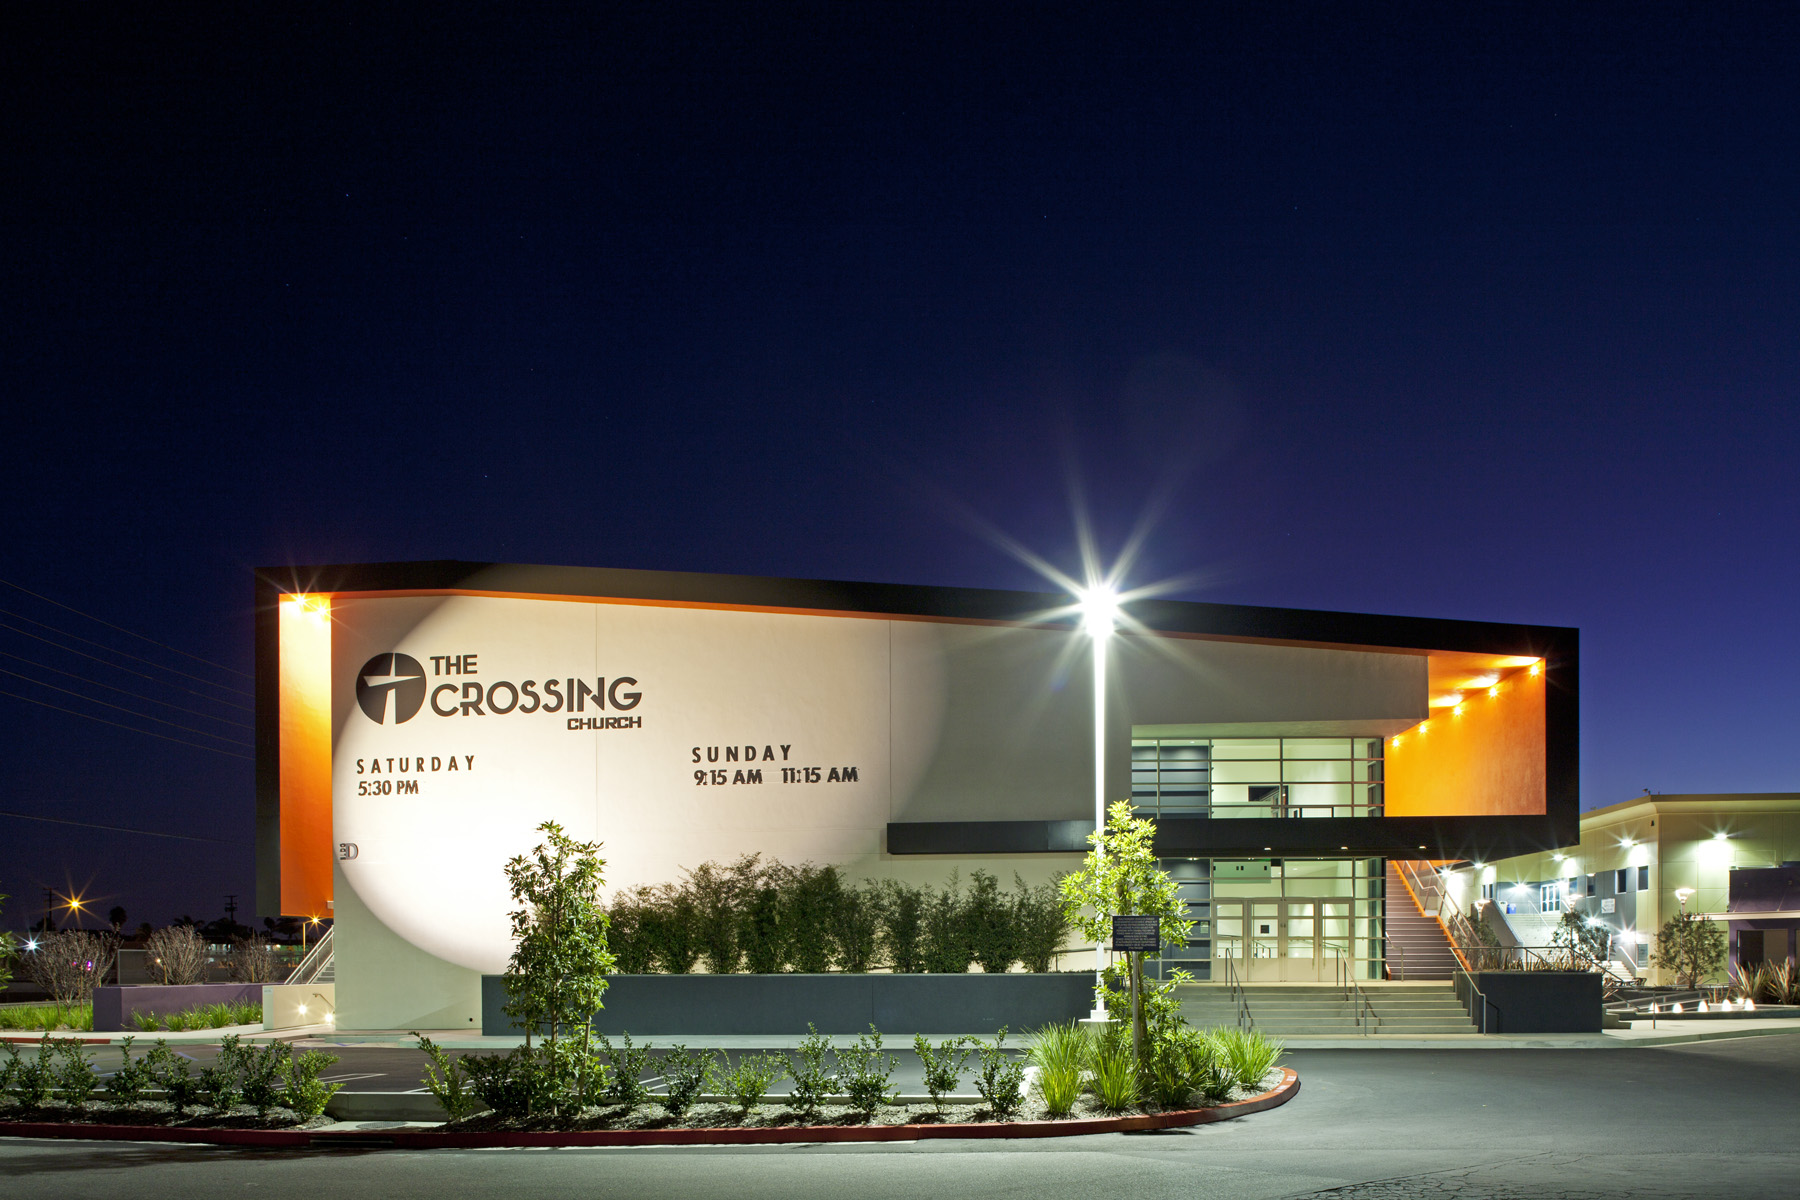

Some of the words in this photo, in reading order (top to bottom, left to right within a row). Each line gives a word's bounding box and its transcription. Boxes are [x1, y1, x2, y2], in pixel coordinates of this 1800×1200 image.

[430, 654, 478, 675] THE
[430, 676, 642, 717] CROSSING
[567, 716, 642, 730] CHURCH
[692, 744, 791, 763] SUNDAY
[356, 755, 475, 774] SATURDAY
[693, 769, 728, 786] 9:15
[732, 768, 763, 785] AM
[780, 767, 822, 783] 11:15
[827, 766, 859, 783] AM
[358, 780, 392, 796] 5:30
[396, 780, 419, 795] PM
